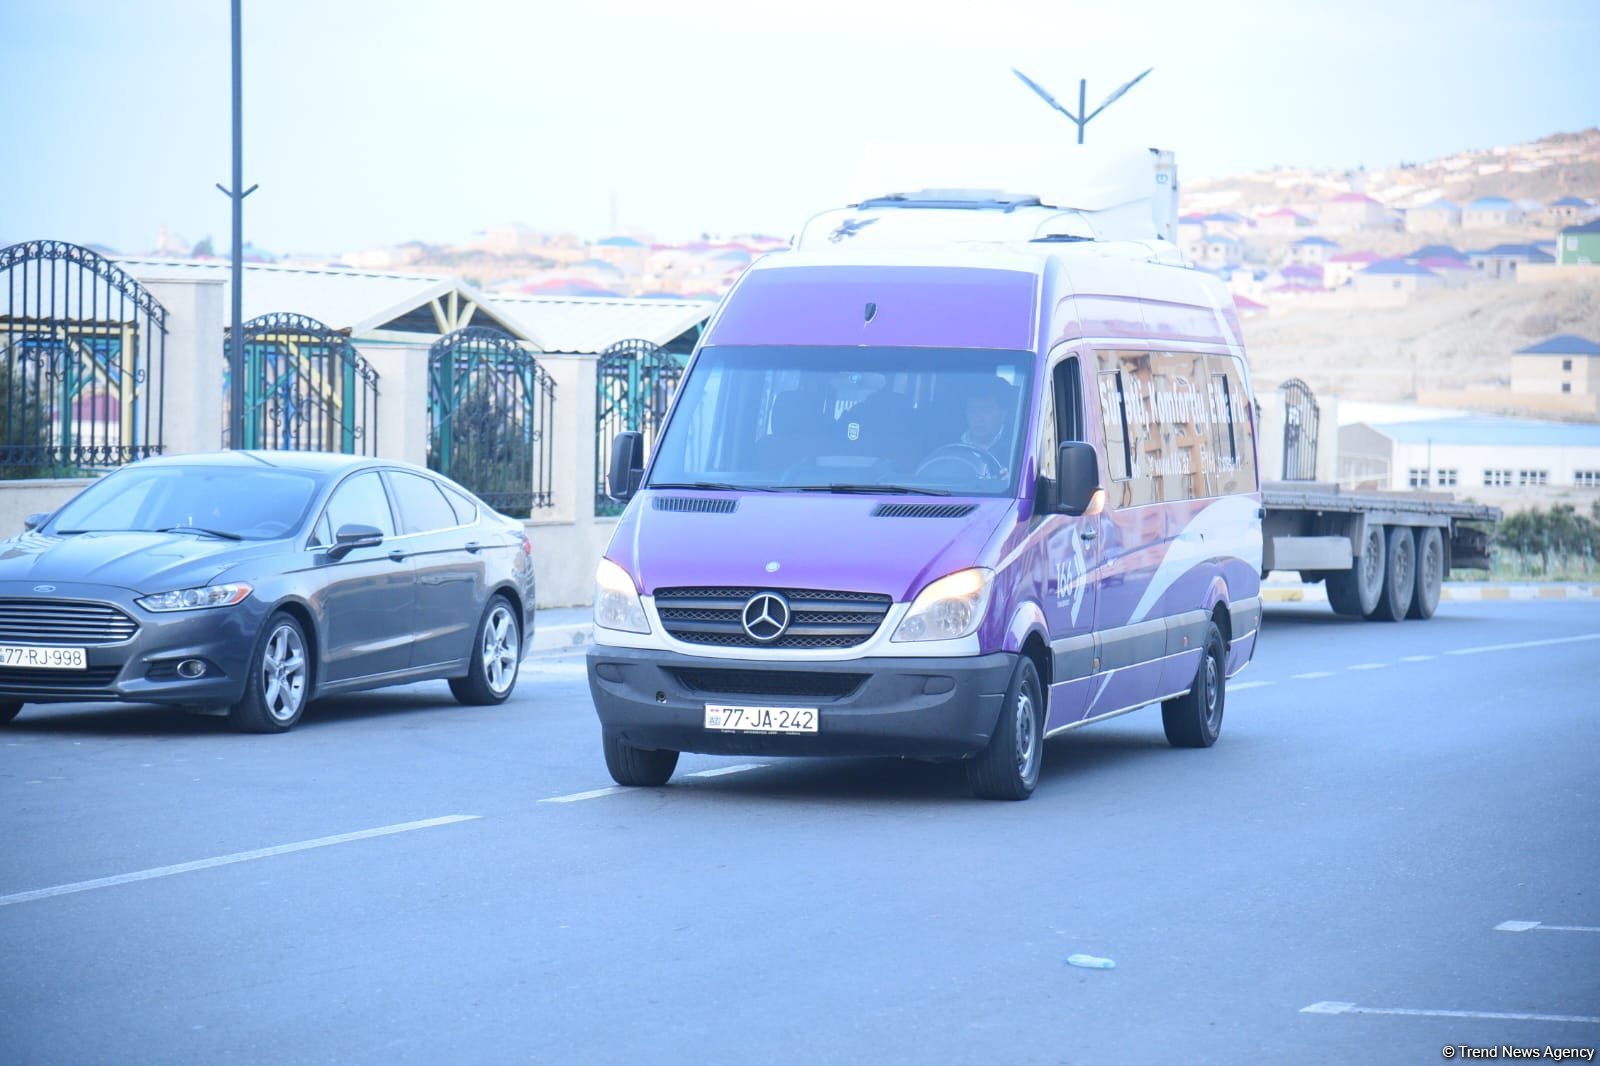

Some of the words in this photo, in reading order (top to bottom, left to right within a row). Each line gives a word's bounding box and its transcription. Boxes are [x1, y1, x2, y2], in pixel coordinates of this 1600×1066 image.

[1056, 561, 1073, 599] 166
[5, 648, 82, 666] 77-RJ-998
[722, 708, 813, 729] 77-JA-242
